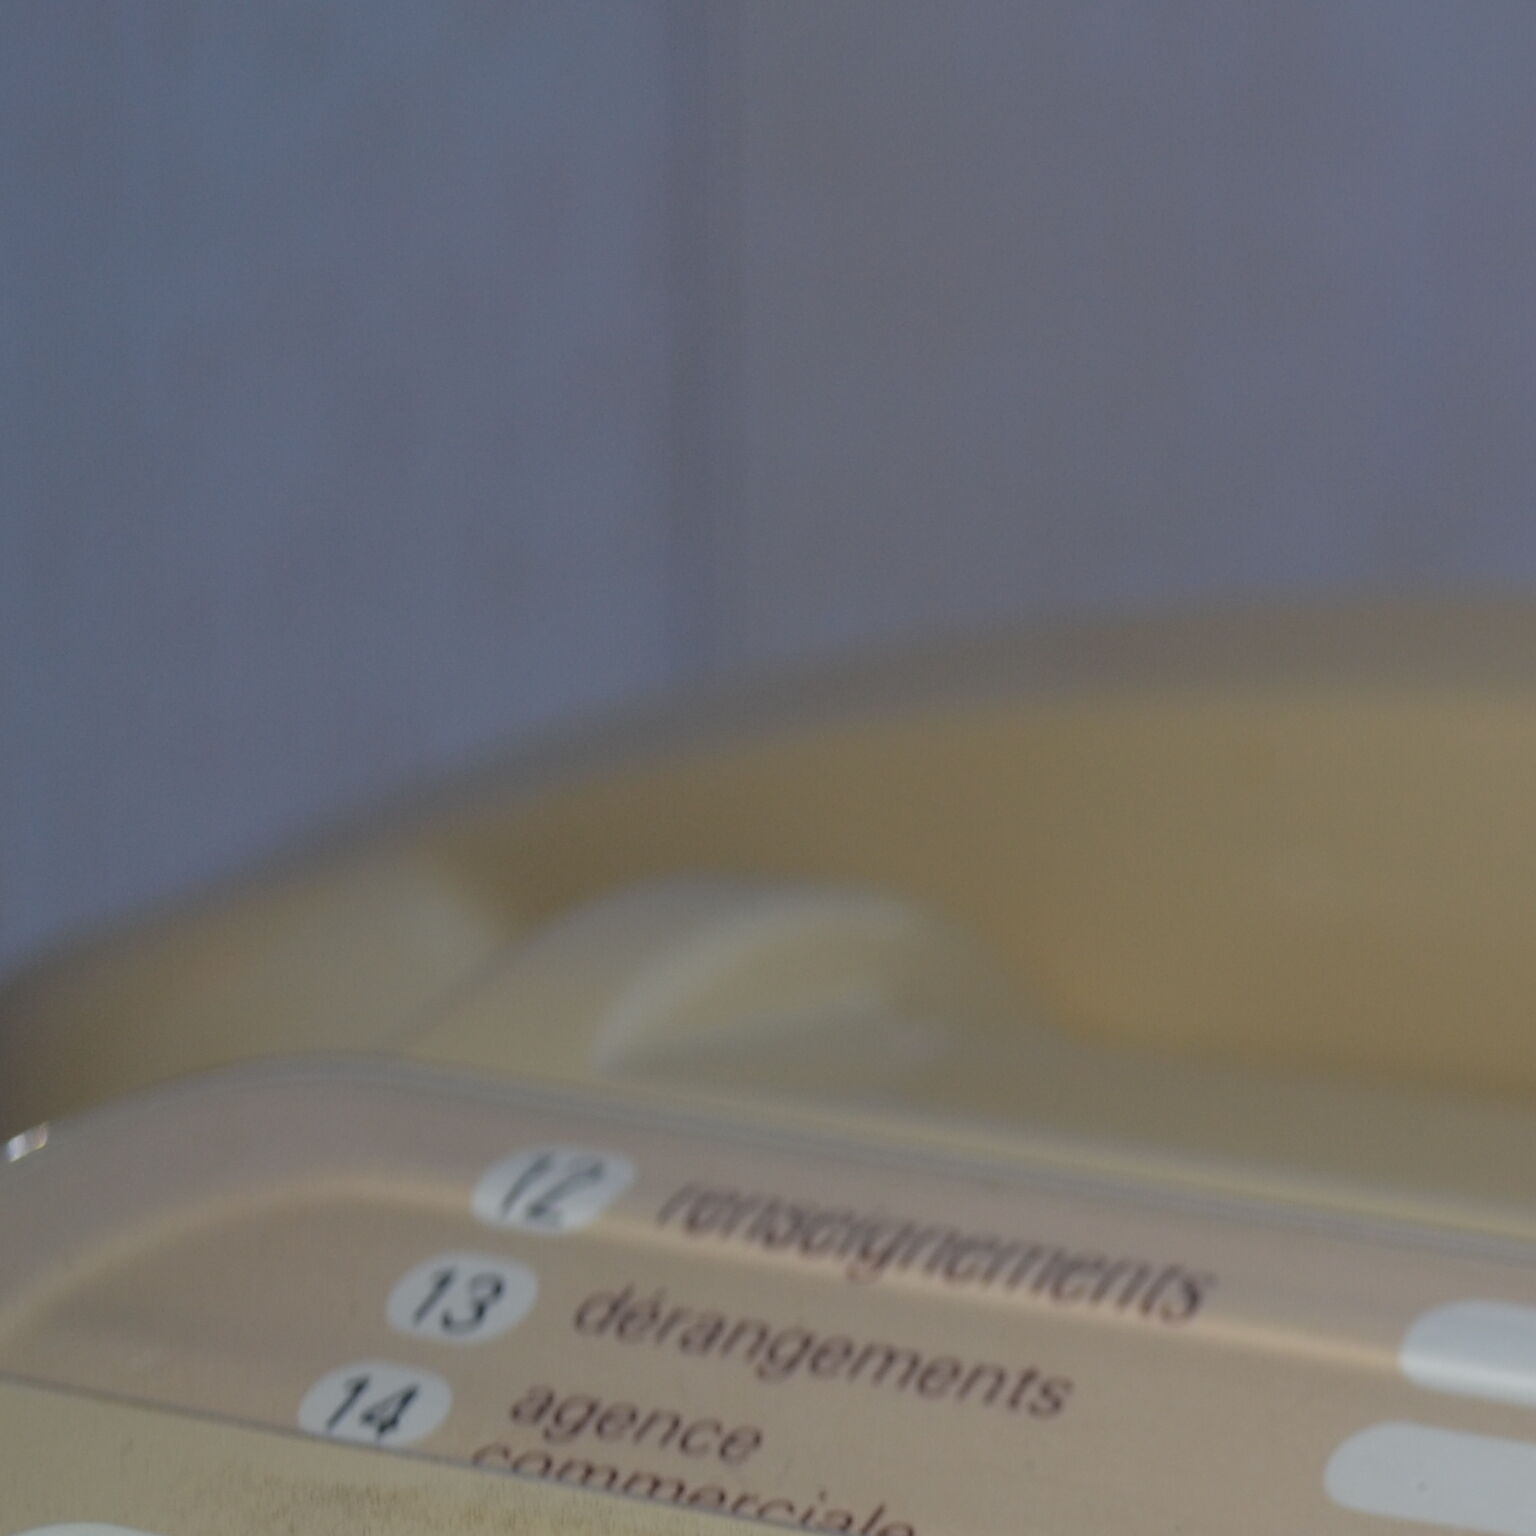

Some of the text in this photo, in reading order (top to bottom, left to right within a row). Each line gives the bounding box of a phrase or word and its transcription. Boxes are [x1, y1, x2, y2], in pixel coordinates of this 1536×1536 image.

[500, 1153, 1218, 1326] 12 renseignements
[412, 1266, 504, 1337] 13
[326, 1373, 765, 1467] 14 agence
